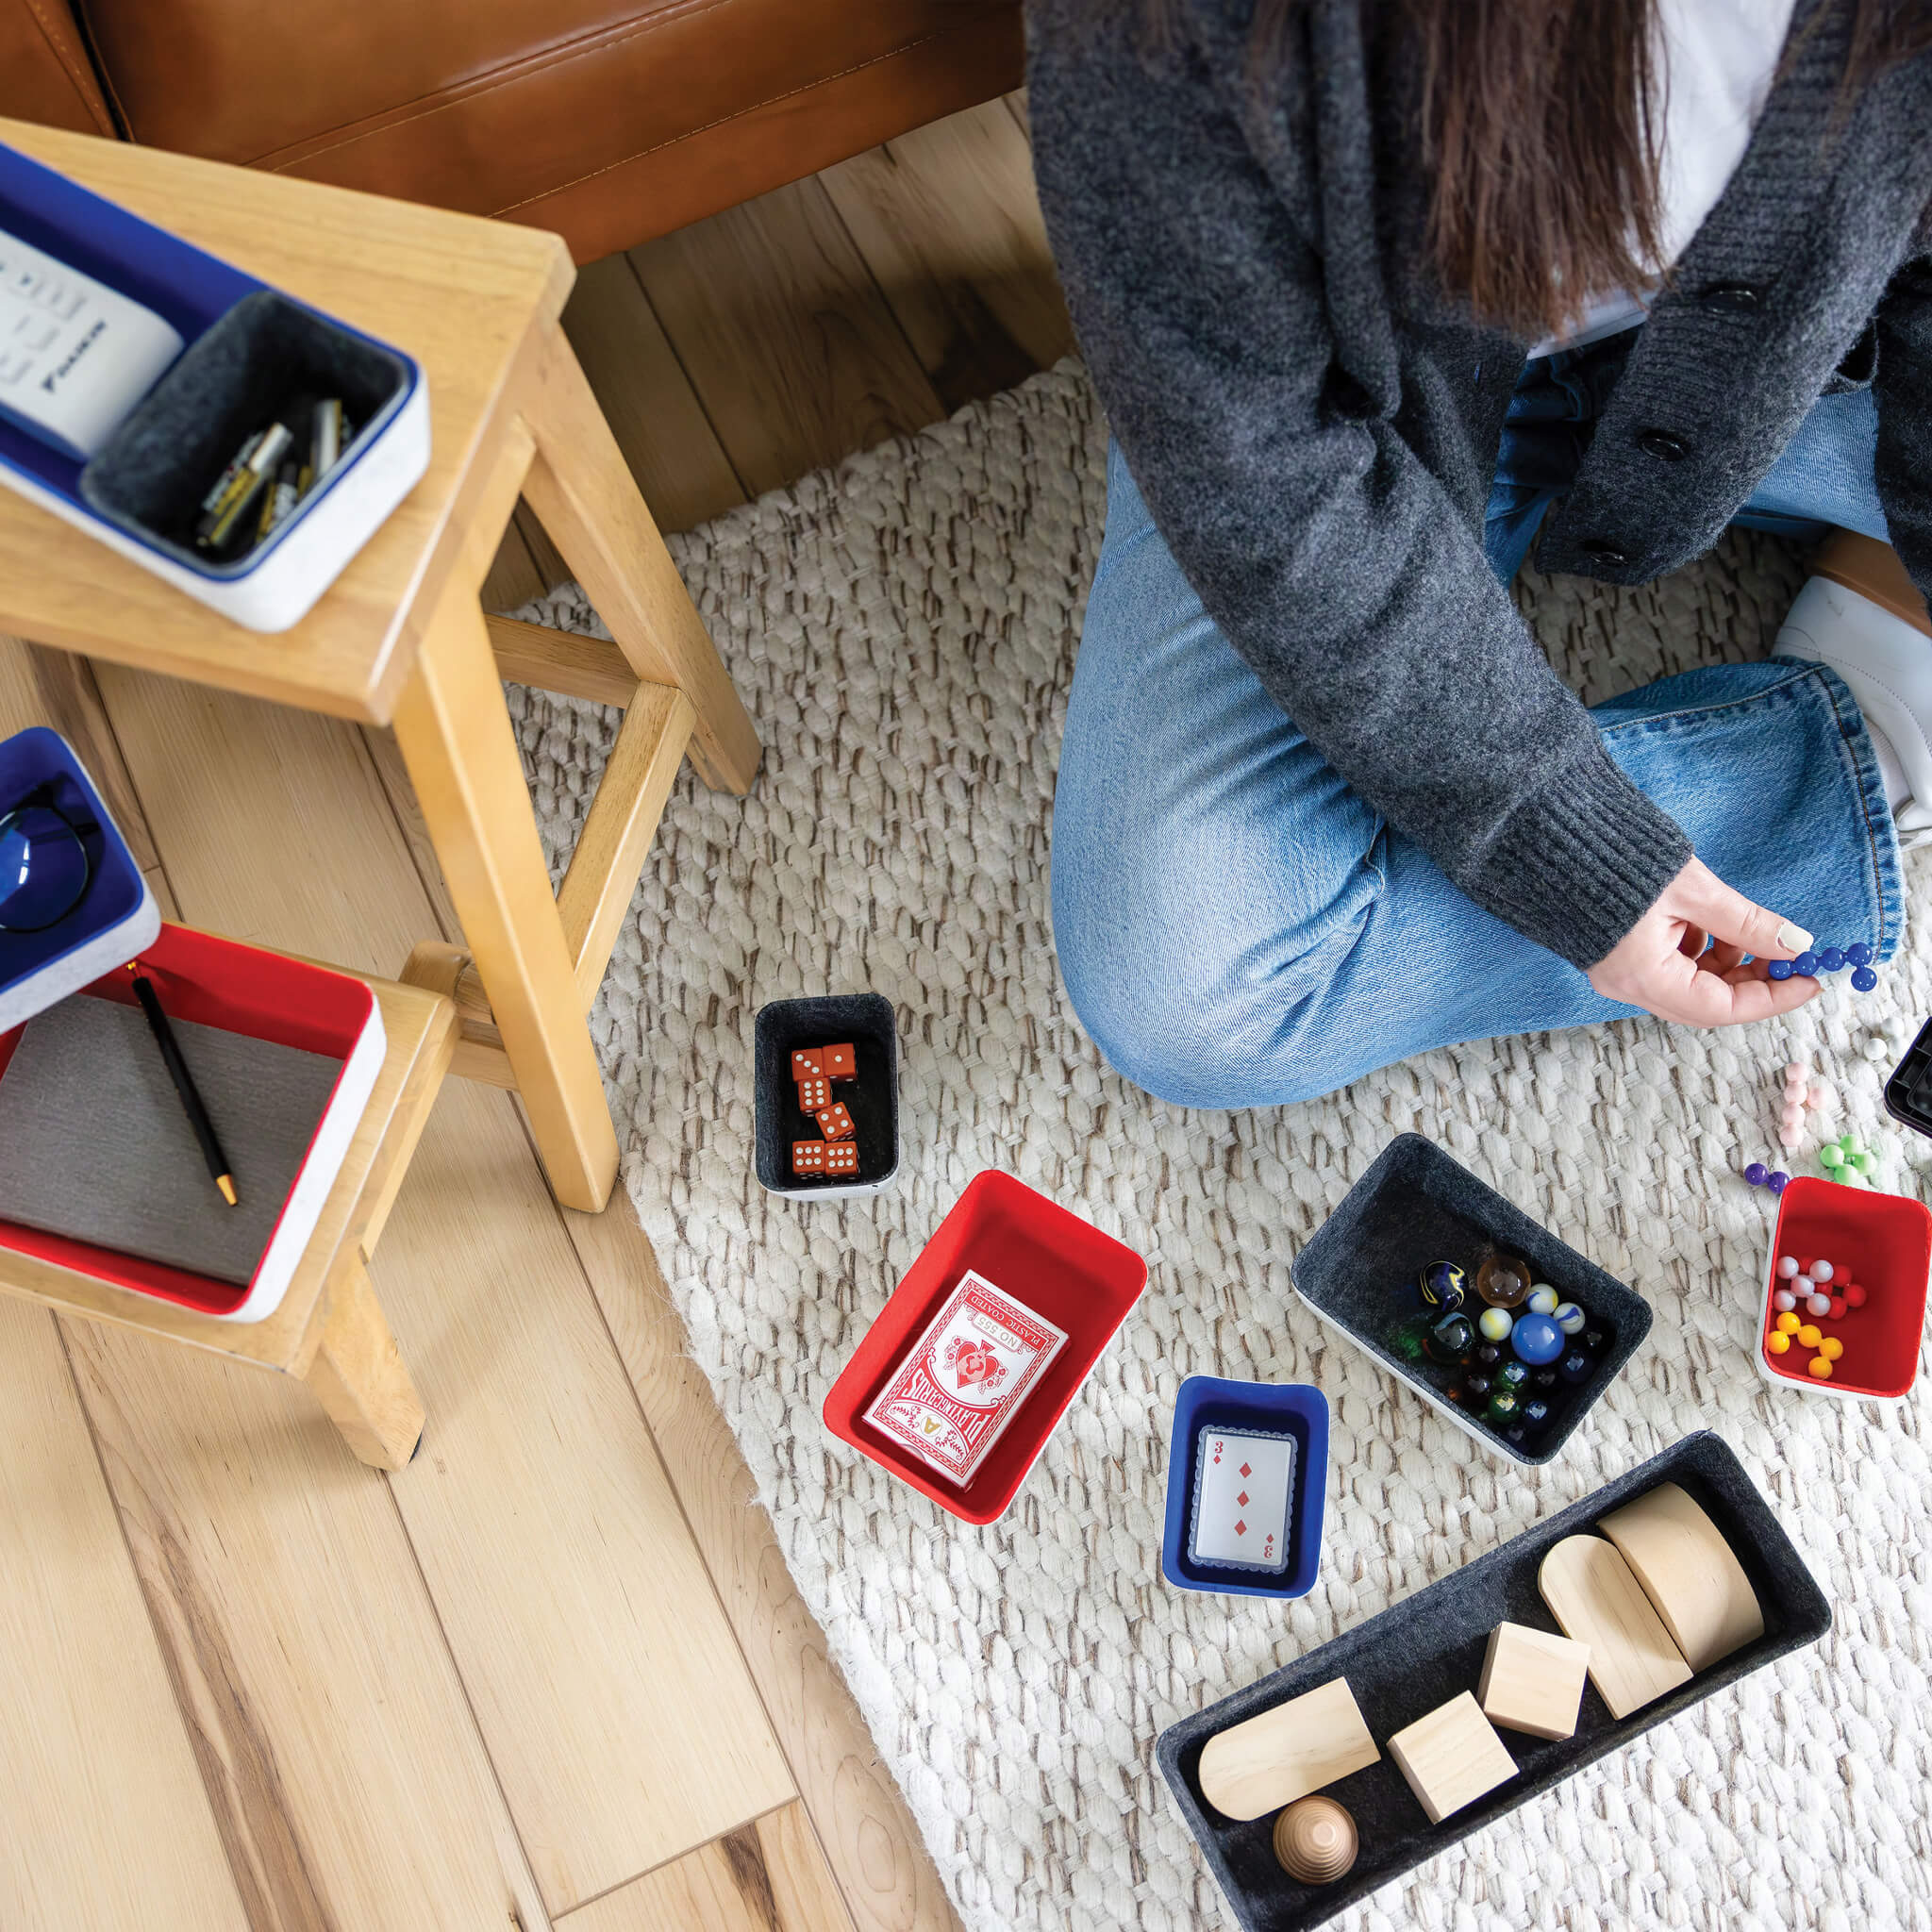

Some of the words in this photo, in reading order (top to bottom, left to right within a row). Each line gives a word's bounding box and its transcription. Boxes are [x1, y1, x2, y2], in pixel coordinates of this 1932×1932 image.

[970, 1295, 1006, 1321] COATED
[1006, 1319, 1041, 1346] PLASTIC
[924, 1416, 941, 1435] A
[1214, 1441, 1224, 1454] 3
[1263, 1545, 1274, 1559] 3
